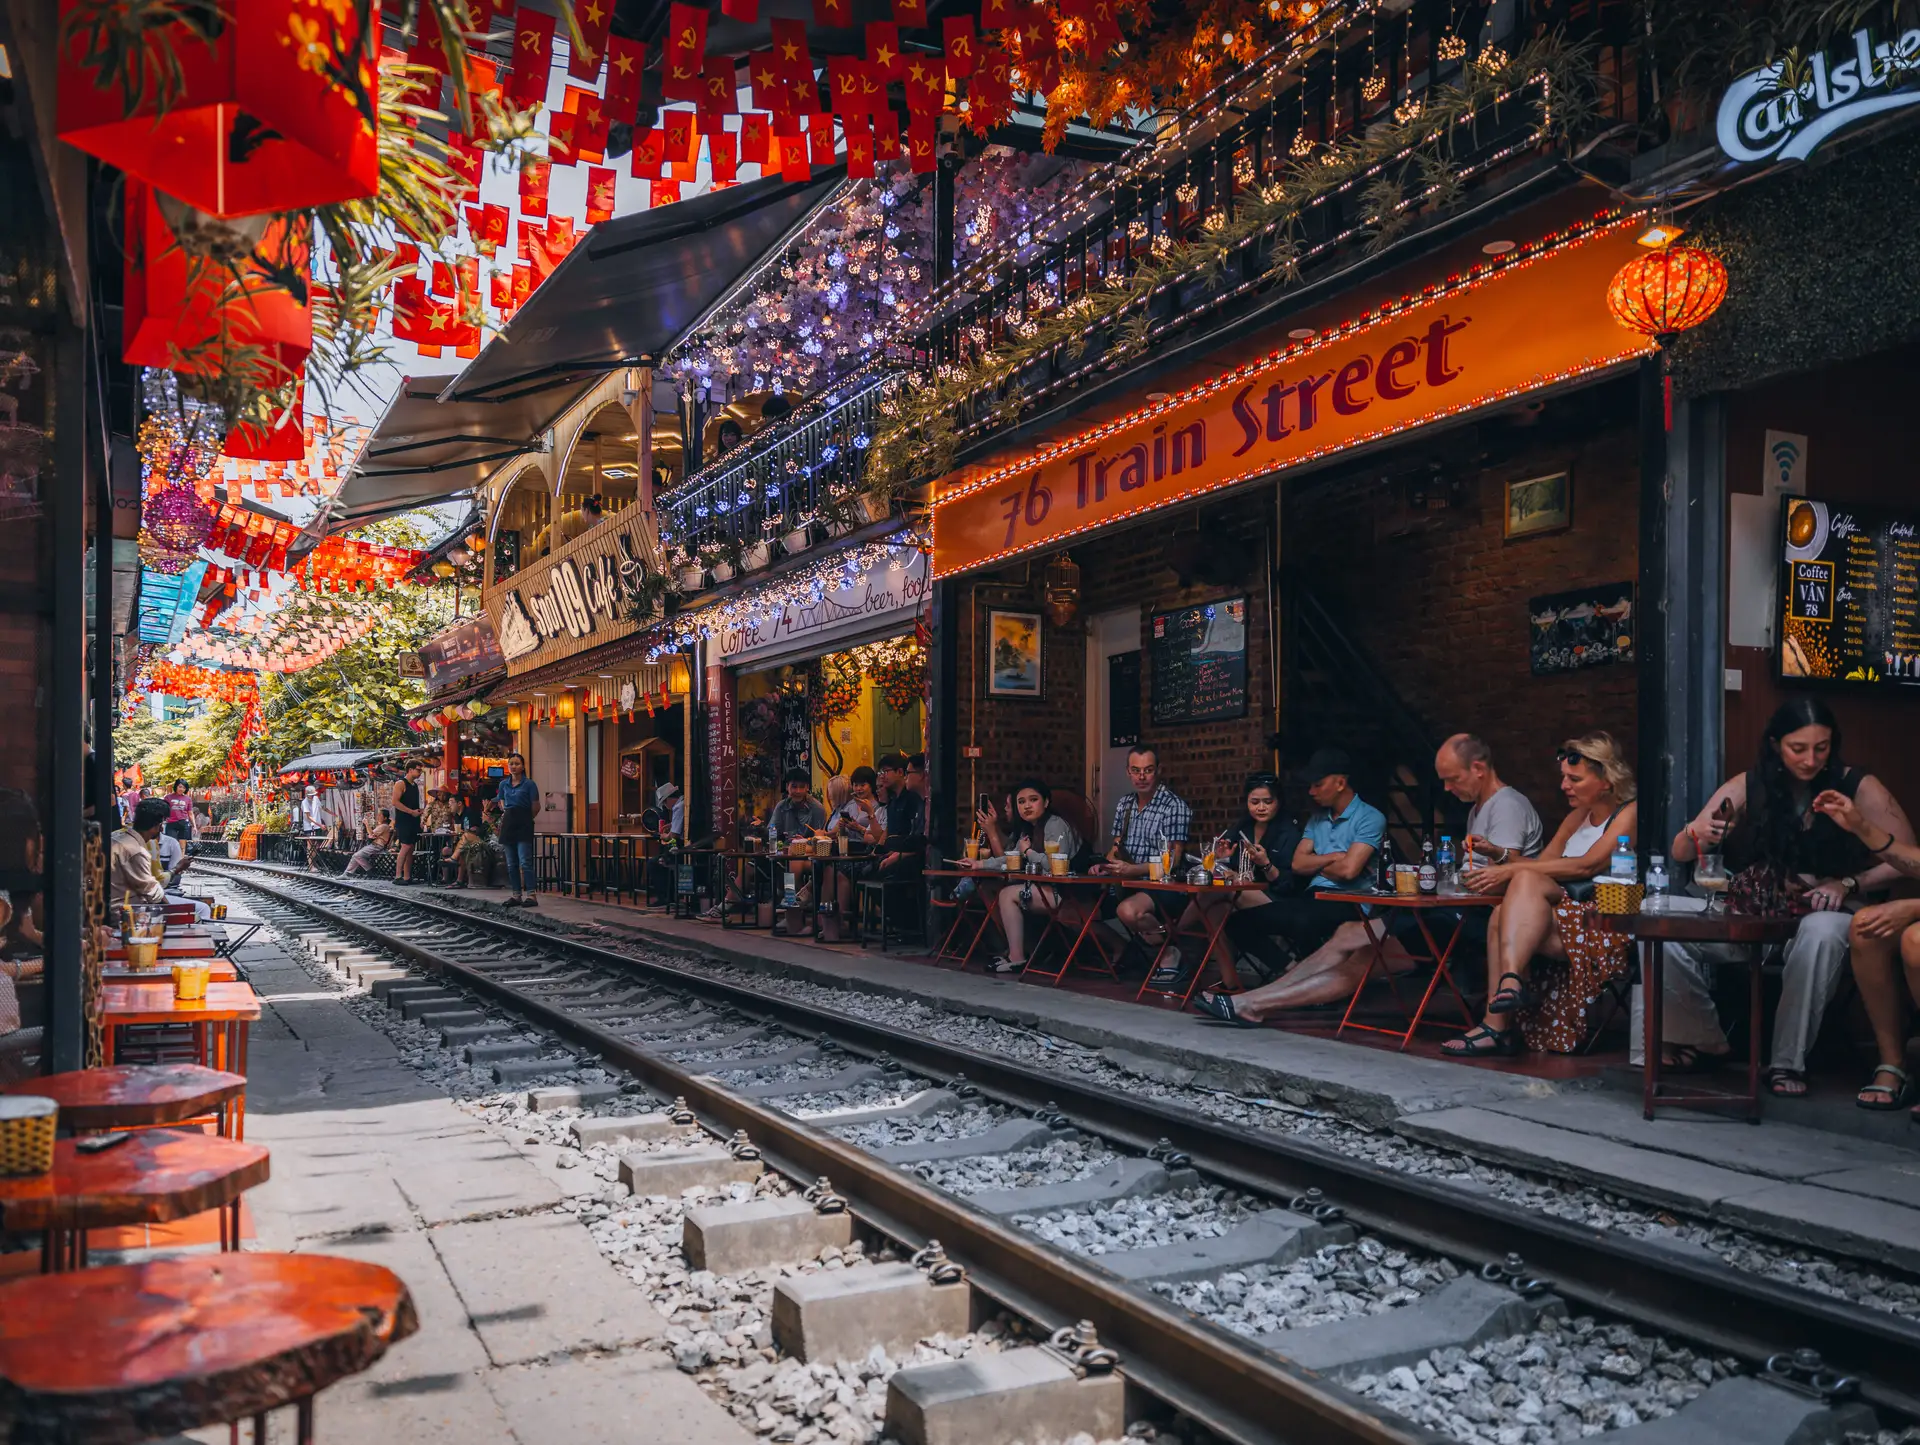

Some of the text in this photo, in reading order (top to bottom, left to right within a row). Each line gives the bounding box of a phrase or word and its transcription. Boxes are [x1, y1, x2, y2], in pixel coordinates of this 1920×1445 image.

[1000, 313, 1473, 549] 76 Train Street
[1799, 564, 1829, 580] Coffee
[550, 560, 592, 639] 09
[583, 554, 617, 621] Café
[864, 583, 899, 613] beer,
[1800, 582, 1826, 603] VÂN
[1804, 604, 1818, 616] 78
[720, 620, 767, 655] Coffee
[724, 692, 732, 741] COFFEE
[722, 745, 735, 757] 74
